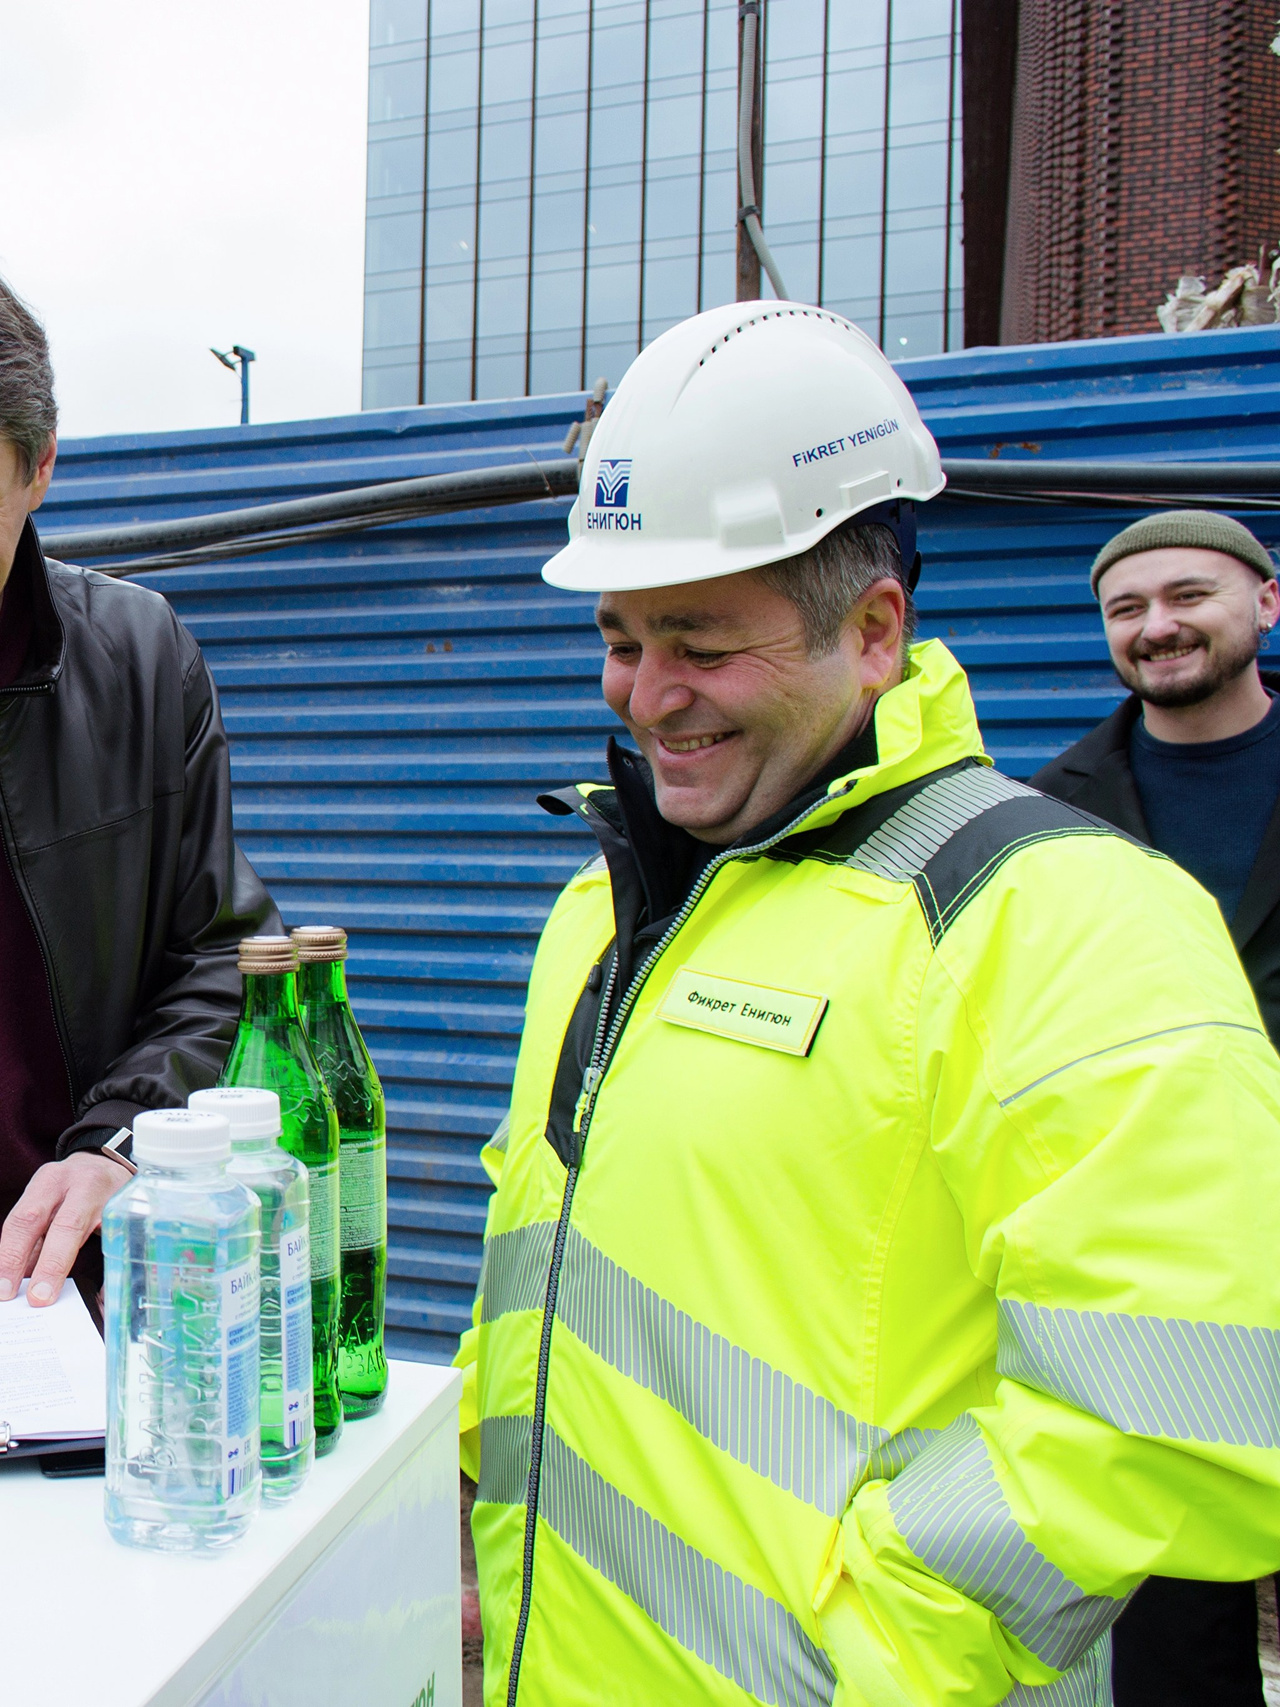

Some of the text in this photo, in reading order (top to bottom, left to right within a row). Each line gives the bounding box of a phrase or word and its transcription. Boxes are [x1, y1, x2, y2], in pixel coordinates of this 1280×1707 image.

[587, 512, 642, 531] ЕНИГЮН
[687, 990, 792, 1027] Фикрет Енигюн
